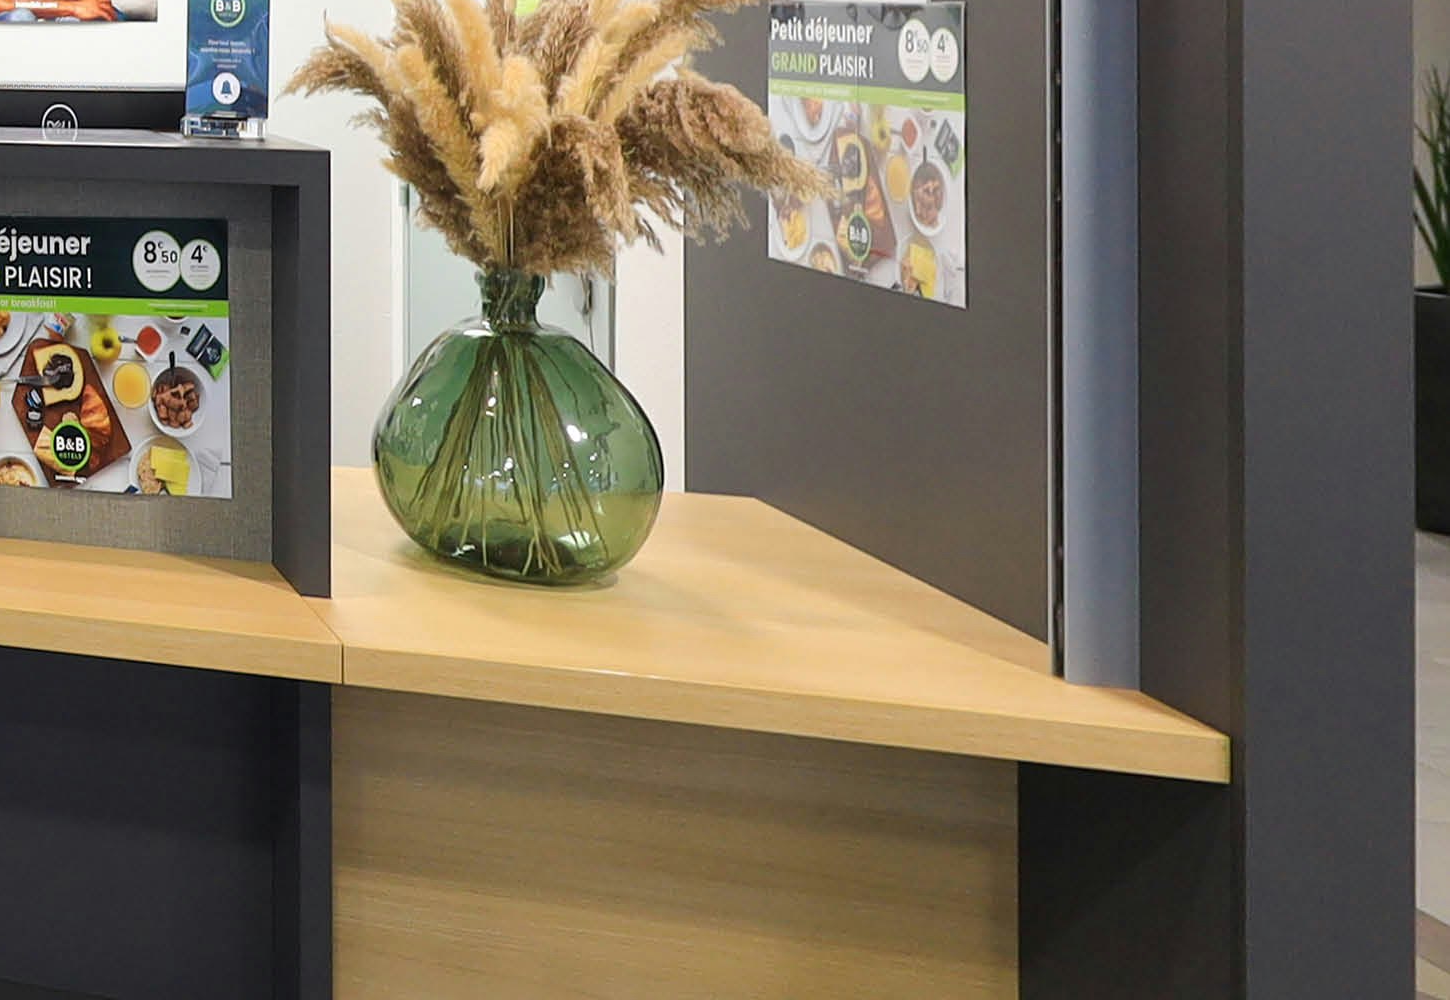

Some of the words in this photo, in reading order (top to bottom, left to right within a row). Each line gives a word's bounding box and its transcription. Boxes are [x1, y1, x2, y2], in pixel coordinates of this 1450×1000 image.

[215, 0, 242, 13] B&B
[770, 16, 803, 41] Petit
[804, 15, 874, 50] déjeuner
[771, 52, 818, 74] GRAND
[819, 53, 867, 78] PLAISIR
[4, 265, 83, 289] PLAISIR
[55, 435, 86, 452] B&B
